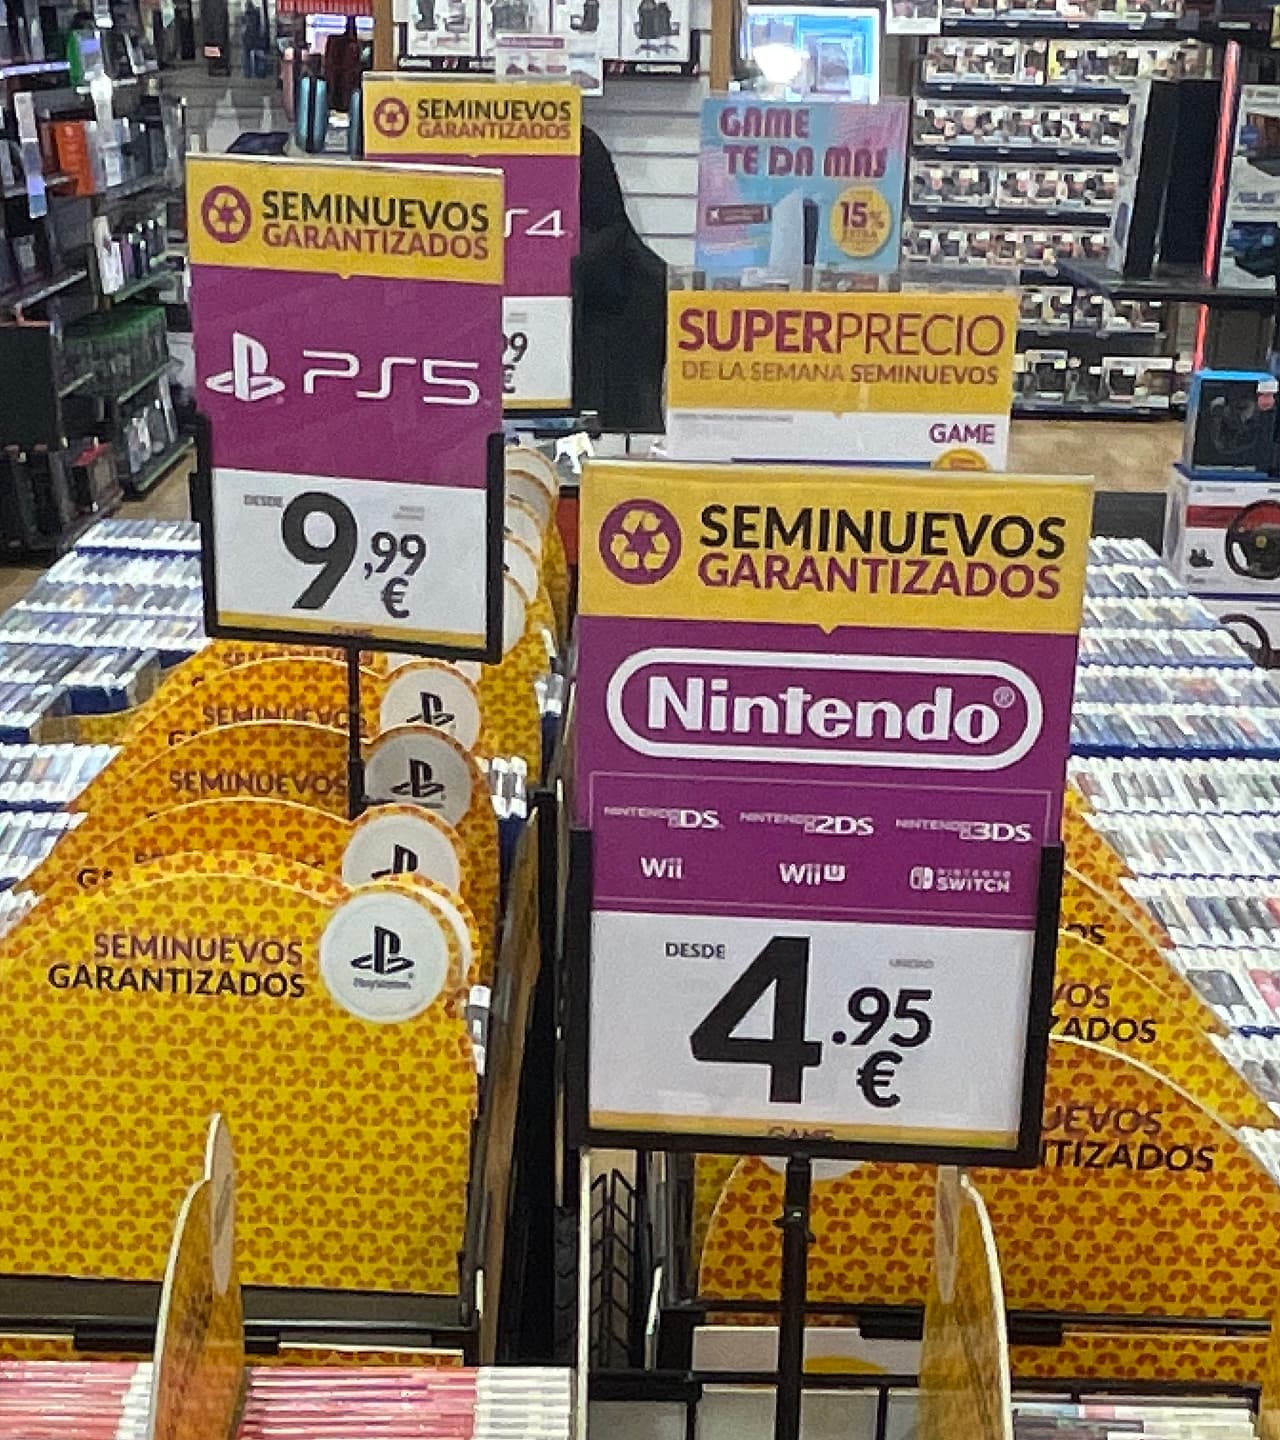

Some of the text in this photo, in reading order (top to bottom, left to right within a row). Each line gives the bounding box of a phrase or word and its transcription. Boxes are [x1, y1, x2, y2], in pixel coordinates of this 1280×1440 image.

[417, 98, 572, 123] SEMINUEVOS
[720, 106, 811, 139] GAME
[417, 120, 572, 140] GARANTIZADOS
[722, 144, 759, 177] TE
[768, 145, 815, 177] DA
[261, 189, 490, 233] SEMINUEVOS
[261, 222, 490, 261] GARANTIZADOS
[677, 308, 1006, 357] SUPERPRECIO
[302, 349, 481, 407] PS5
[681, 360, 999, 385] DE LA SEMANA SEMINUEVOS
[928, 423, 996, 445] GAME
[699, 504, 1067, 561] SEMINUEVOS
[697, 552, 1061, 599] GARANTIZADOS
[169, 769, 347, 797] SEMINUEVOS
[640, 856, 684, 881] Wii
[935, 876, 1012, 894] SWITCH
[93, 932, 304, 968] SEMINUEVOS
[664, 940, 727, 961] DESDE
[48, 963, 306, 1000] GARANTIZADOS
[856, 1050, 904, 1109] €
